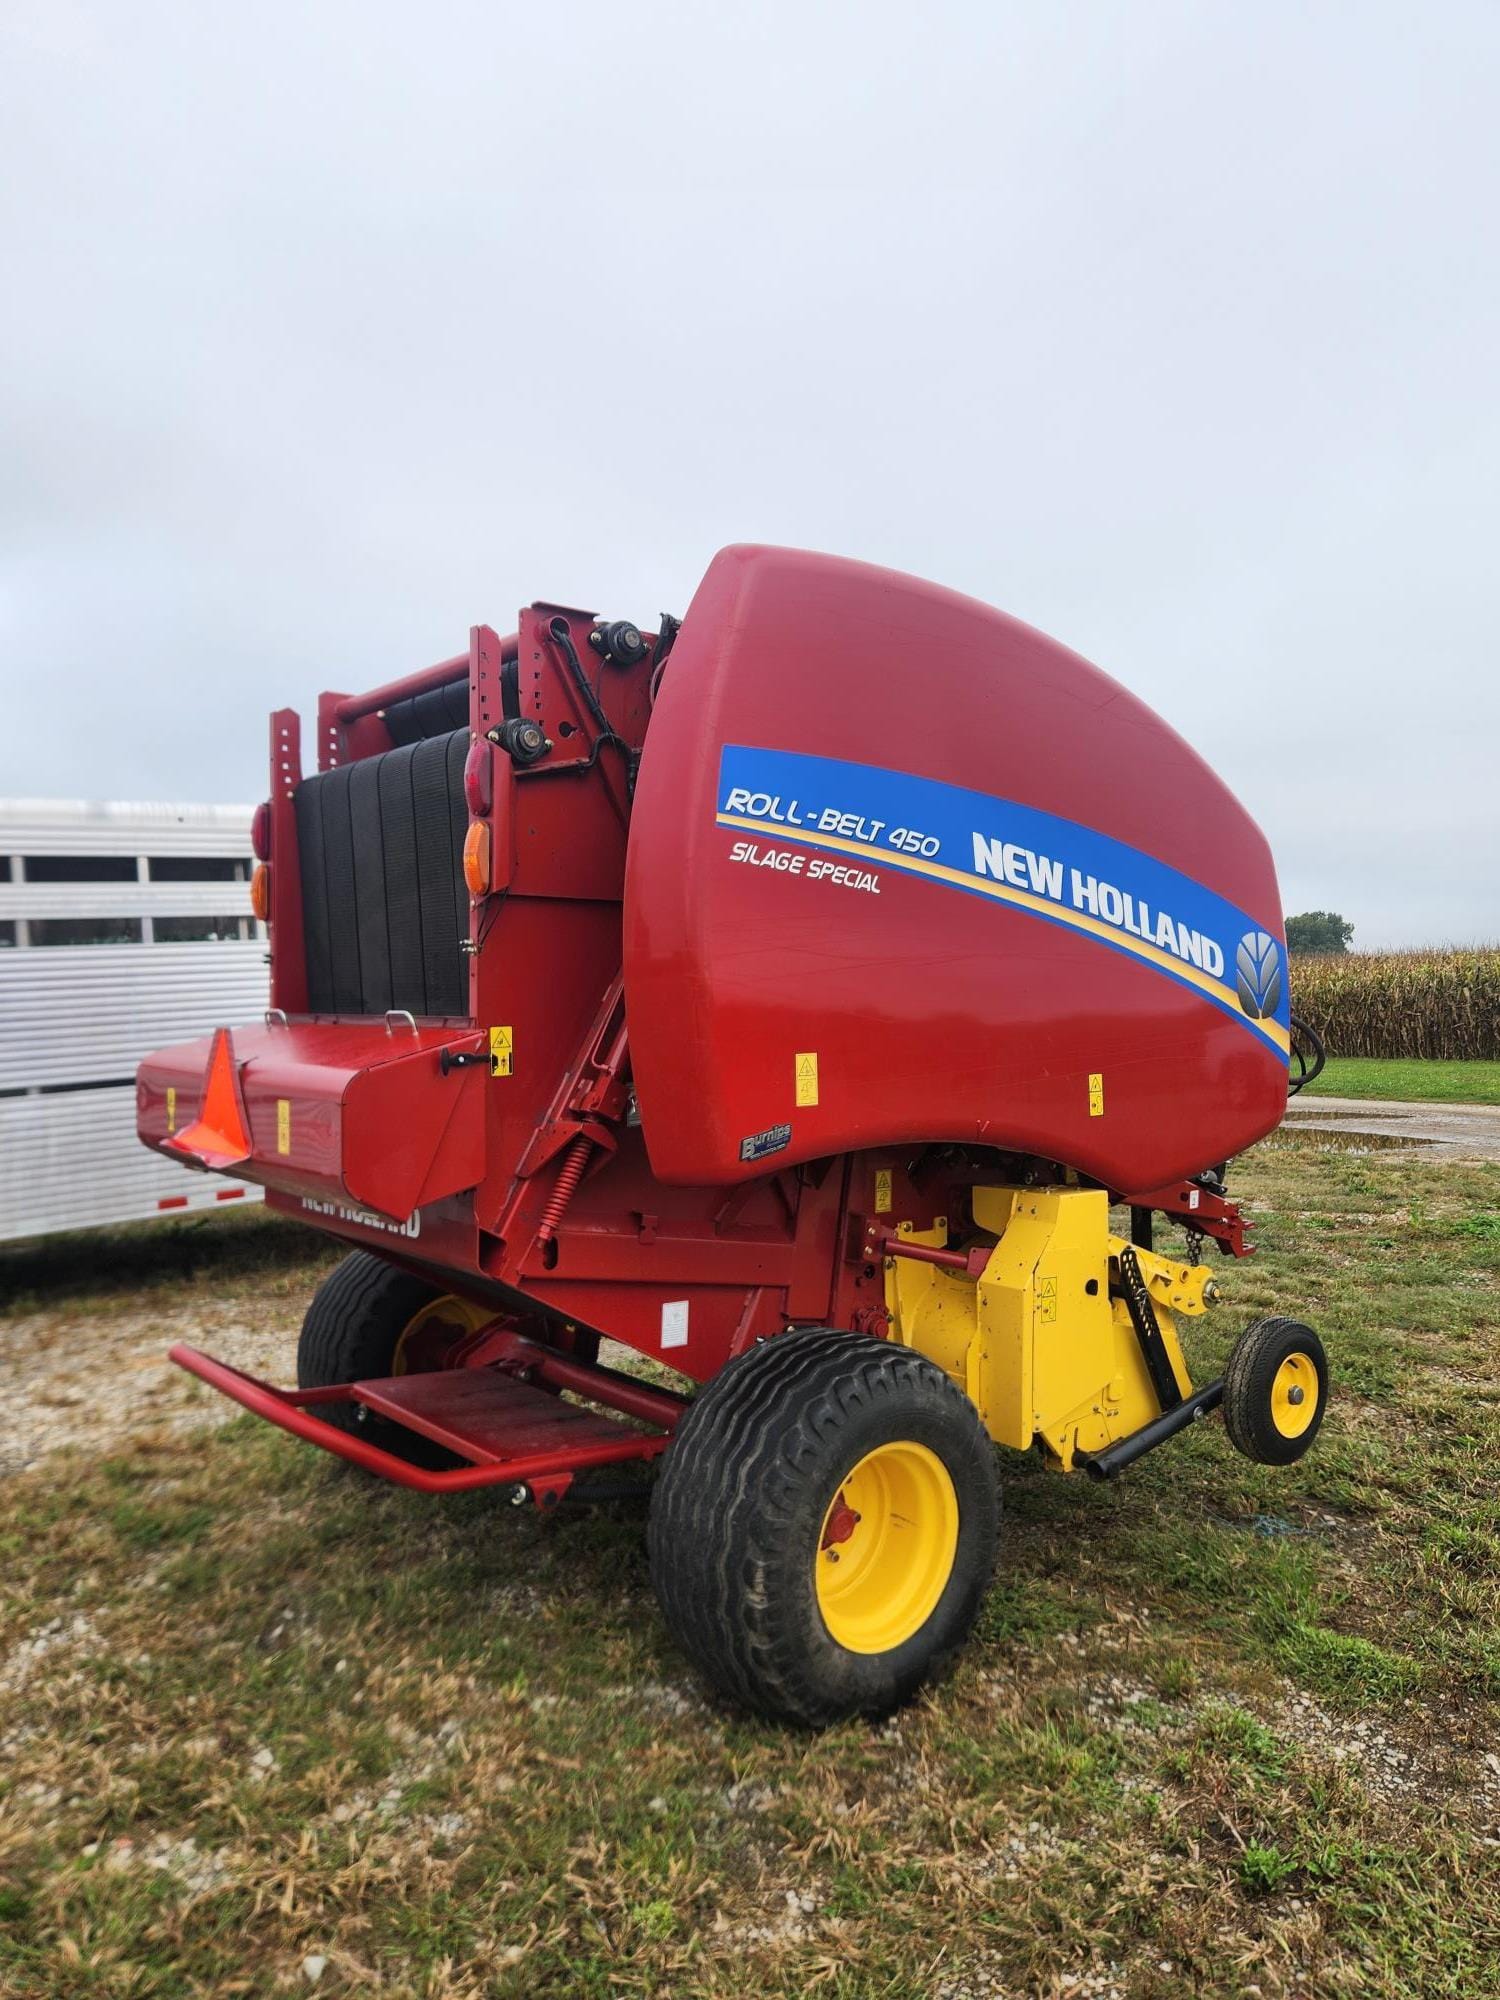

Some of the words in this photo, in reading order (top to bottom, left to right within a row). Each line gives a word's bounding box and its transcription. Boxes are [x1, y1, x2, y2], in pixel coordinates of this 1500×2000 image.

[725, 788, 885, 842] ROLL-BELT
[888, 828, 940, 857] 450
[729, 842, 806, 874] SILAGE
[806, 860, 881, 894] SPECIAL
[972, 831, 1064, 901] NEW
[1070, 868, 1225, 978] HOLLAND
[742, 1124, 791, 1159] Burnips
